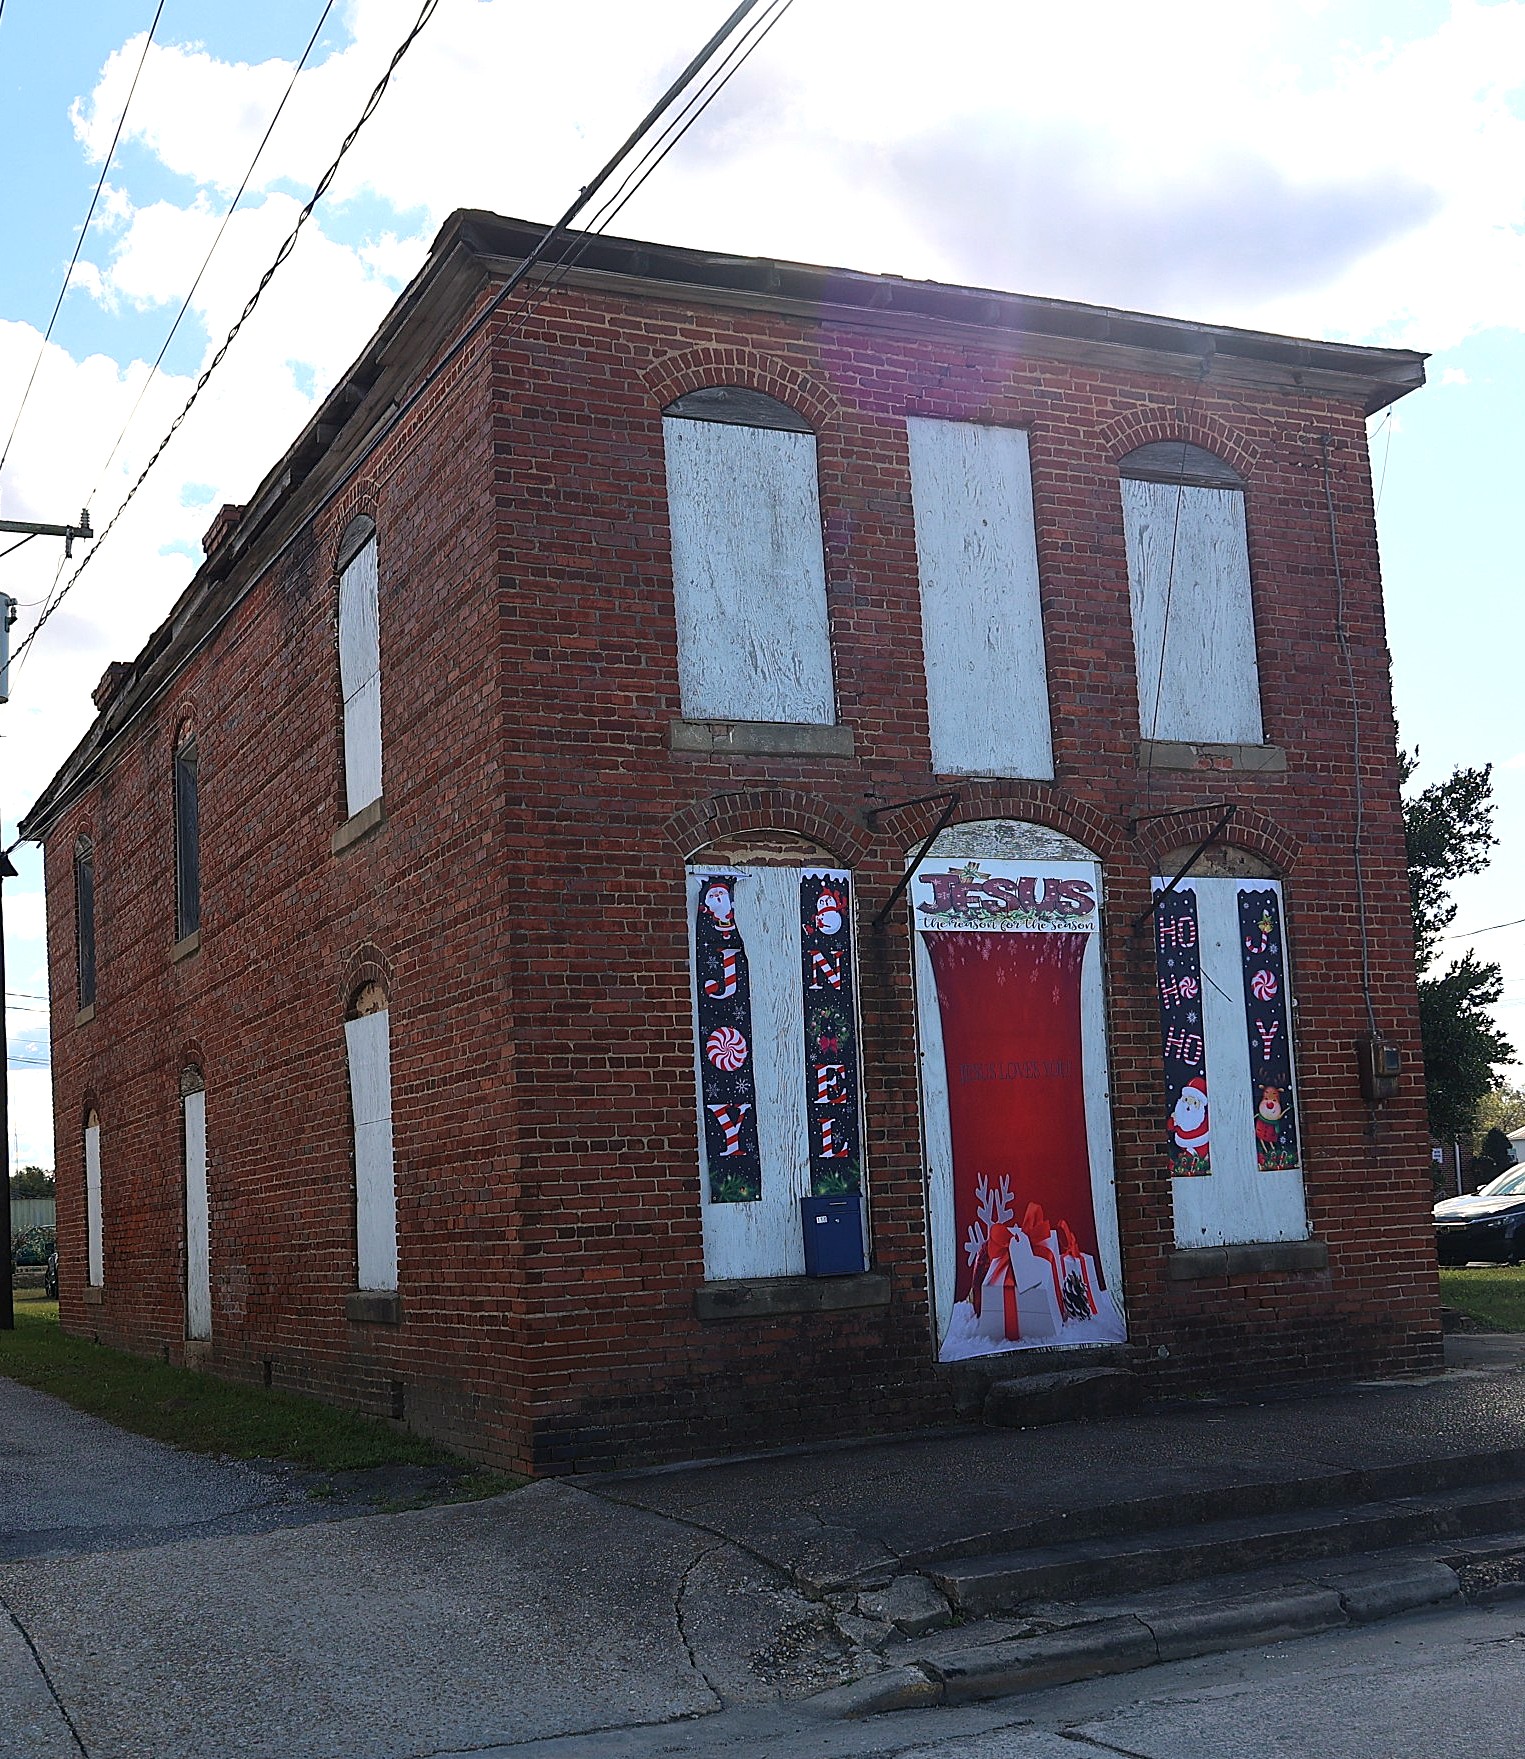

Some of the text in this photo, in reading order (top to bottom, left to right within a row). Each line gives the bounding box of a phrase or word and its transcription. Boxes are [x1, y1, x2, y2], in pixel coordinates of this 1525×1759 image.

[916, 873, 1096, 916] JESUS
[923, 917, 1095, 932] the reason for the season
[1158, 915, 1196, 950] HO
[1165, 1025, 1202, 1065] HO
